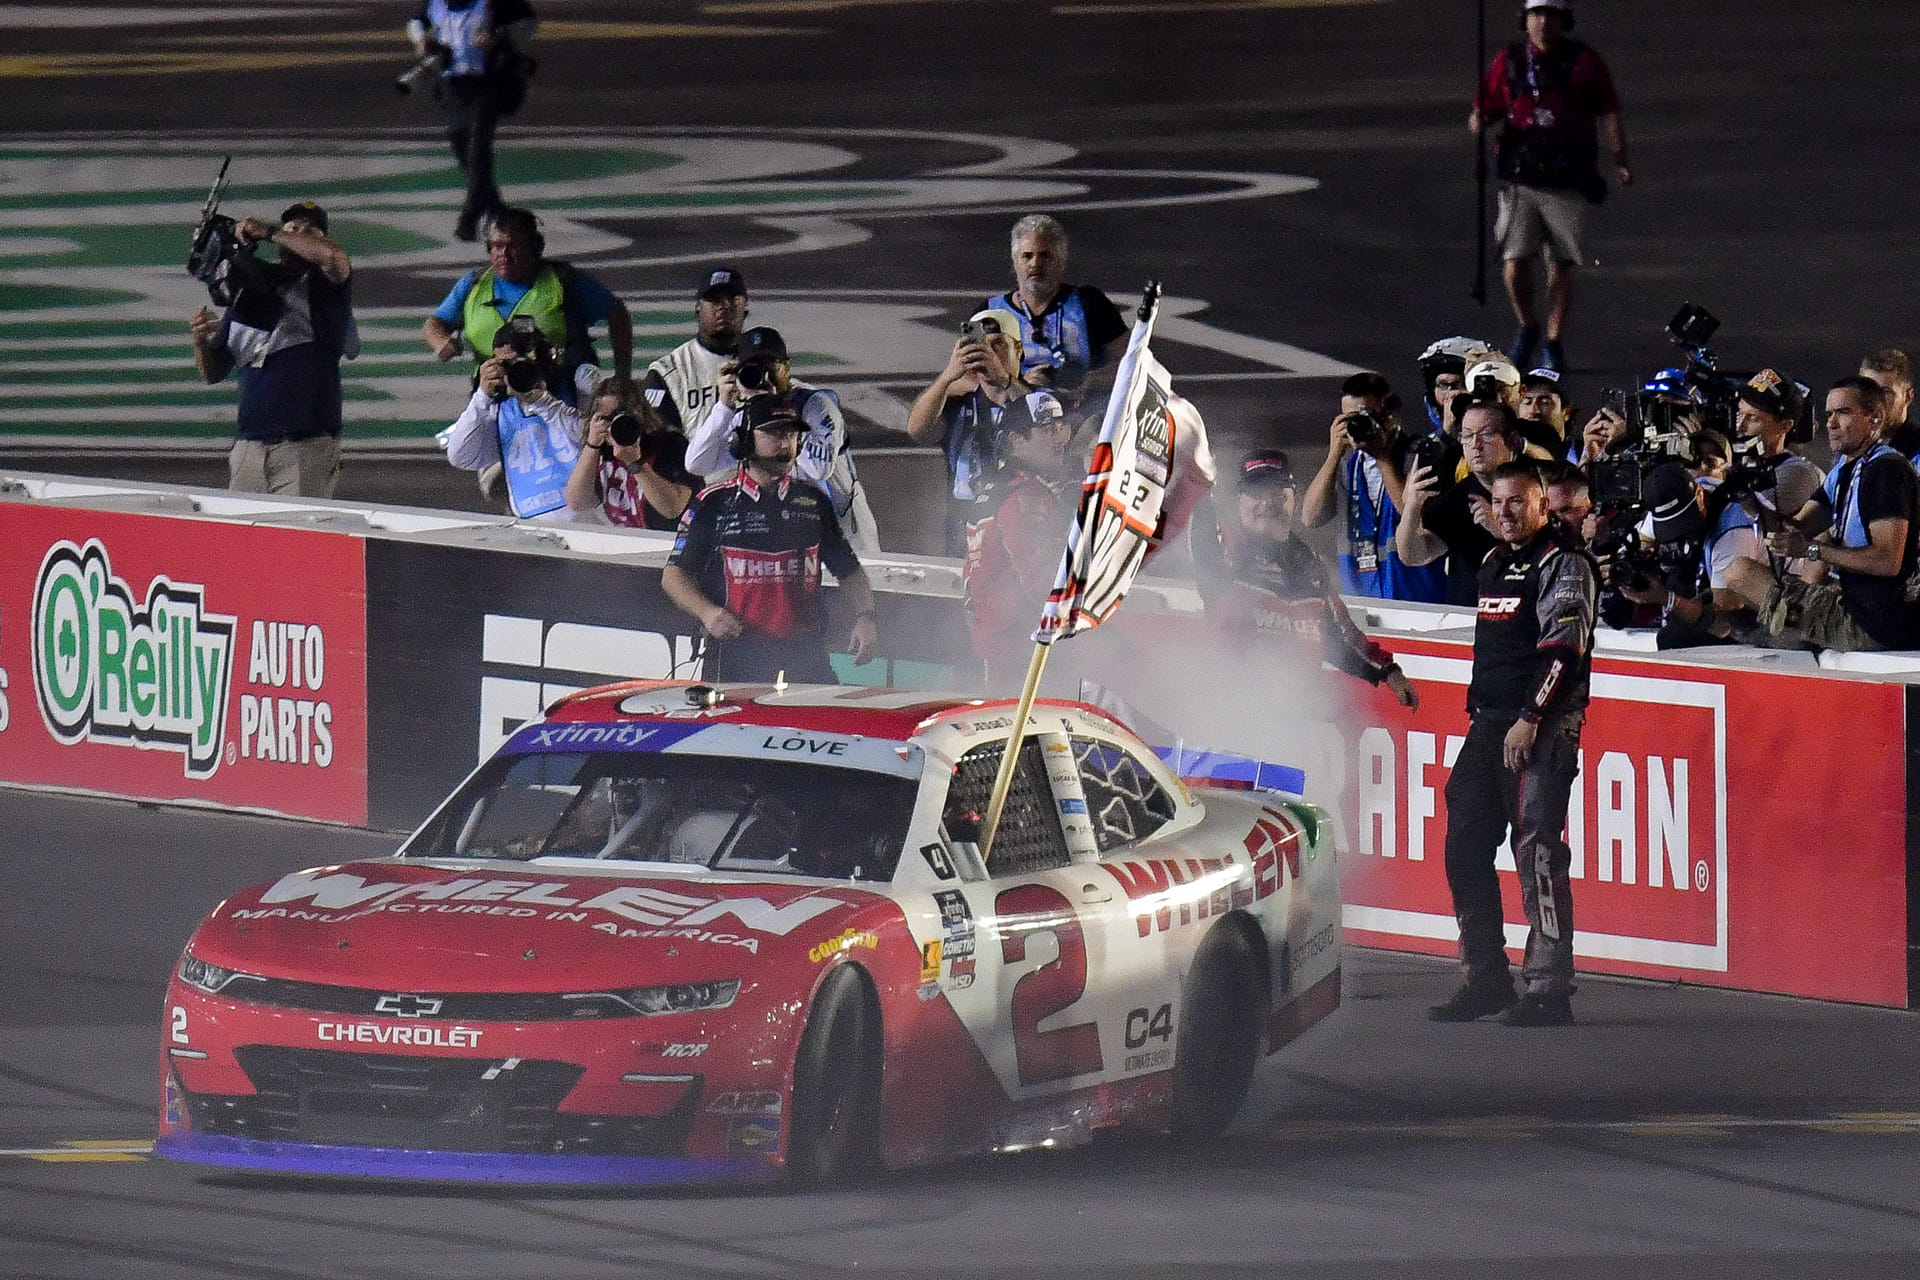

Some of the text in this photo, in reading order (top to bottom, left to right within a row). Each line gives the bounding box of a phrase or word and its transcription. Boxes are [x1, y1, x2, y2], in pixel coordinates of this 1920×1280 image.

[726, 553, 818, 578] WHELEN
[36, 552, 228, 762] O'Reilly
[248, 620, 324, 691] AUTO
[240, 694, 333, 768] PARTS
[531, 723, 660, 747] xfinity
[762, 735, 849, 756] LOVE
[1298, 720, 1690, 892] RAFAN
[931, 848, 949, 875] 4
[258, 870, 848, 937] WHELEN
[546, 911, 587, 922] IN
[591, 922, 759, 954] AMERICA
[994, 883, 1105, 1087] 2
[171, 1004, 190, 1045] 2
[317, 1022, 484, 1048] CHEVROLET
[1124, 1003, 1175, 1050] C4
[660, 1043, 709, 1058] RCR
